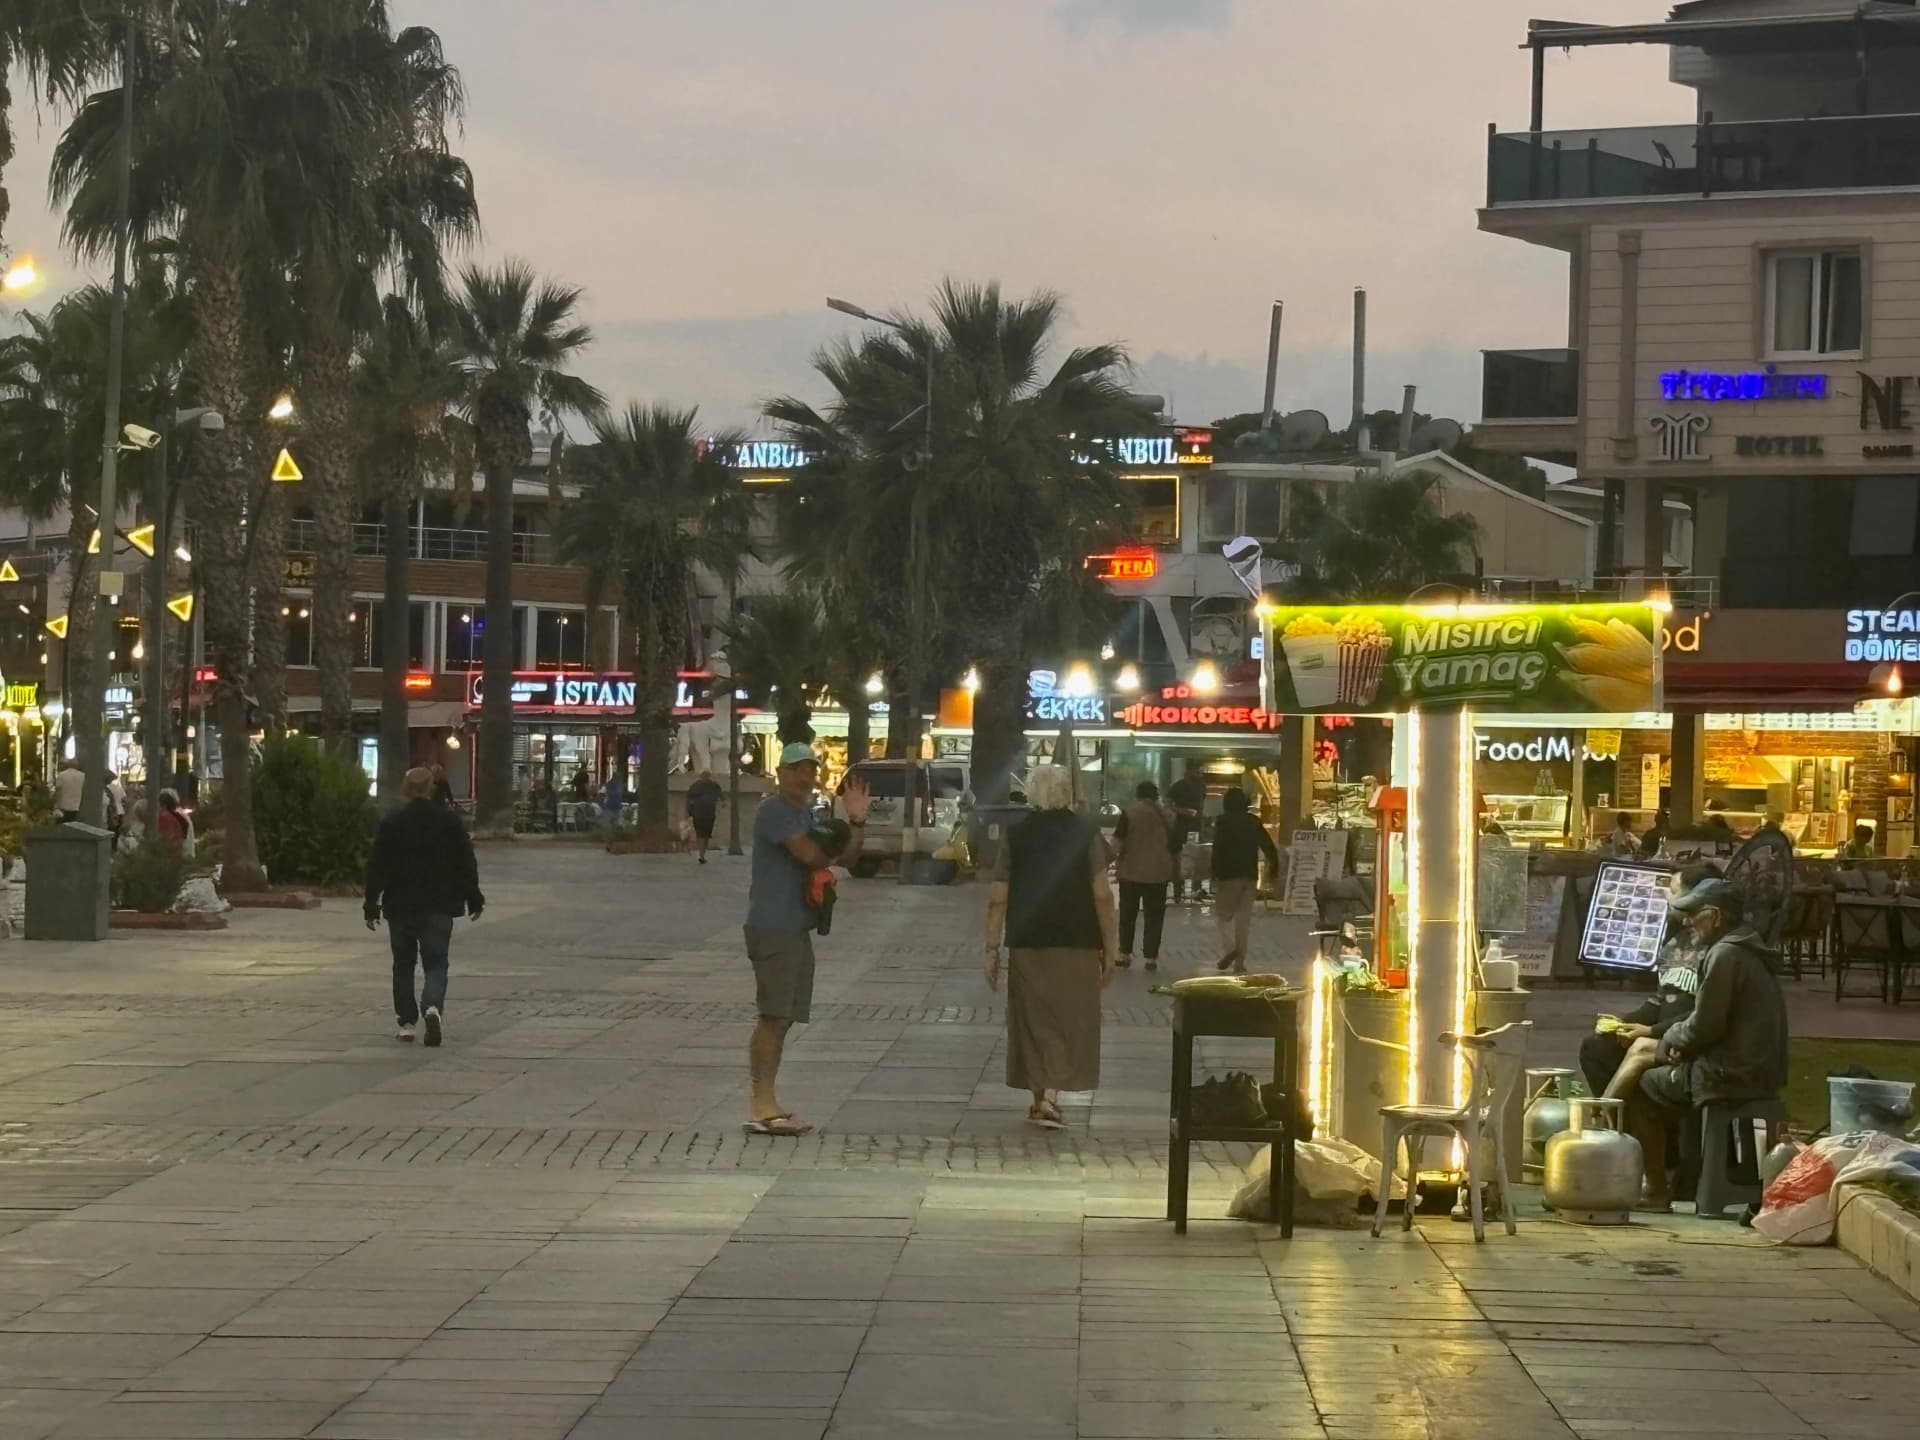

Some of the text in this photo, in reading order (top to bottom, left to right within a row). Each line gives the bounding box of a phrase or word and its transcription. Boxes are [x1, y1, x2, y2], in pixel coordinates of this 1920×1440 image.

[1856, 370, 1920, 430] NE
[1736, 436, 1823, 456] HOTEL
[1846, 610, 1920, 632] STEA
[1844, 634, 1920, 662] DÖNE
[1394, 656, 1545, 692] Yamaç
[554, 675, 694, 707] İSTANL
[1036, 698, 1104, 721] EKMEK
